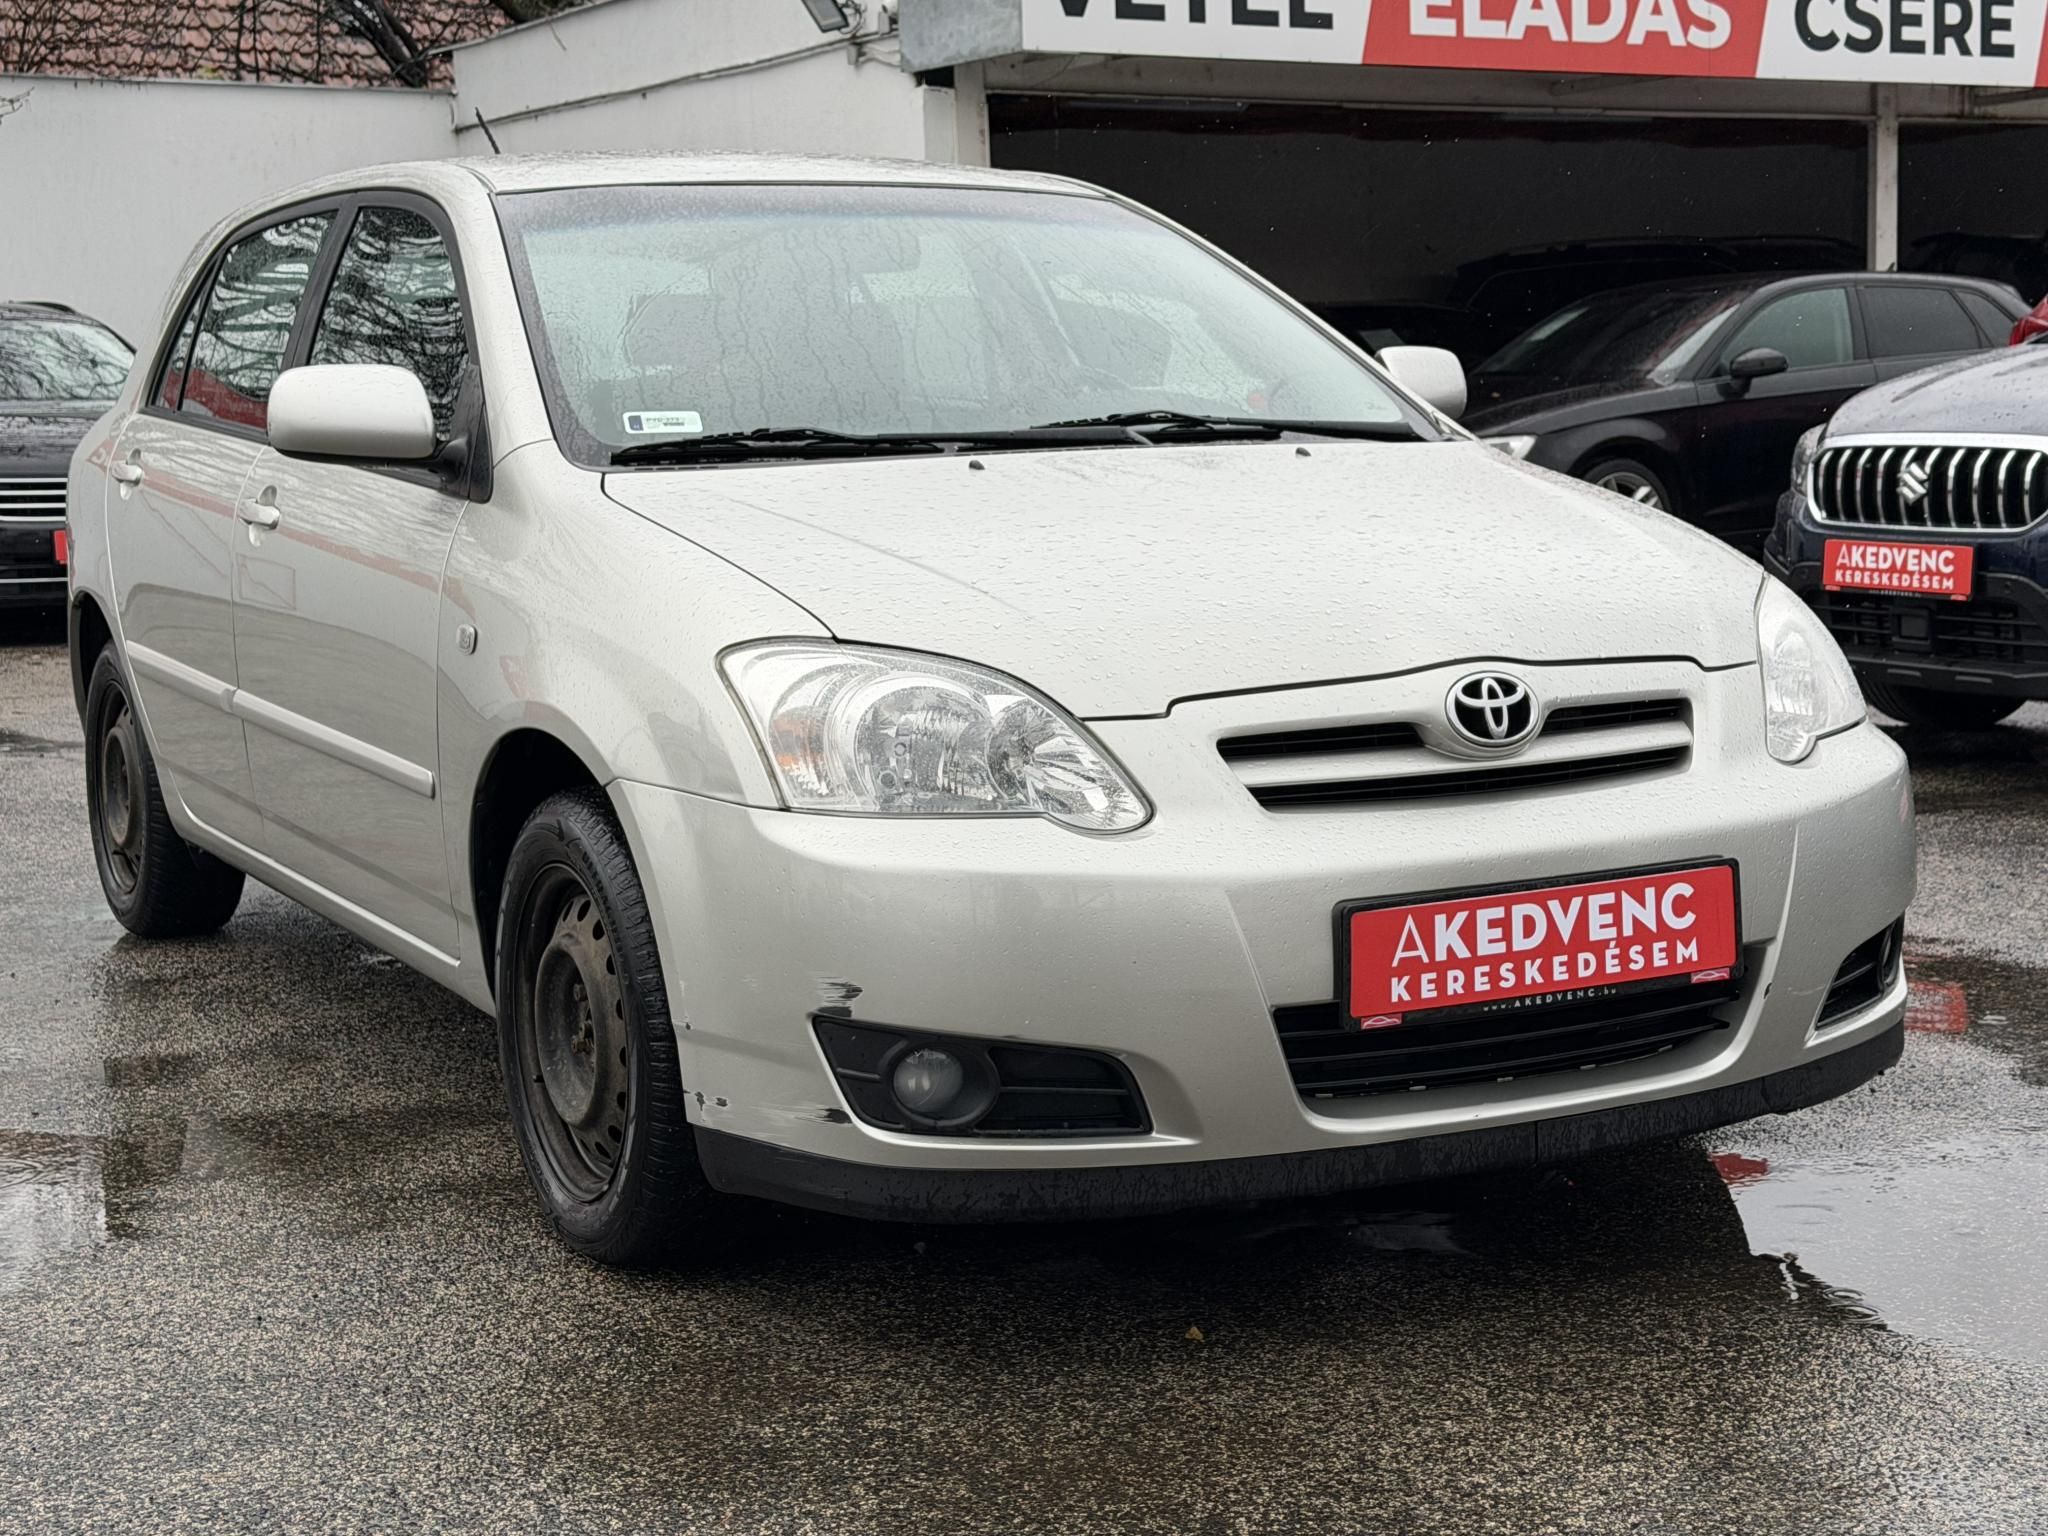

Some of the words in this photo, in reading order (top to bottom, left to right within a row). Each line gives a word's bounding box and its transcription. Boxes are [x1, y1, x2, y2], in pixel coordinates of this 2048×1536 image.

[1794, 0, 2015, 58] CSERE
[1835, 569, 1955, 590] KERESKEDÉSEM
[1836, 544, 1955, 574] AKEDVENC
[1391, 882, 1697, 968] AKEDVENC
[1390, 937, 1699, 1003] KERESKEDÉSEM
